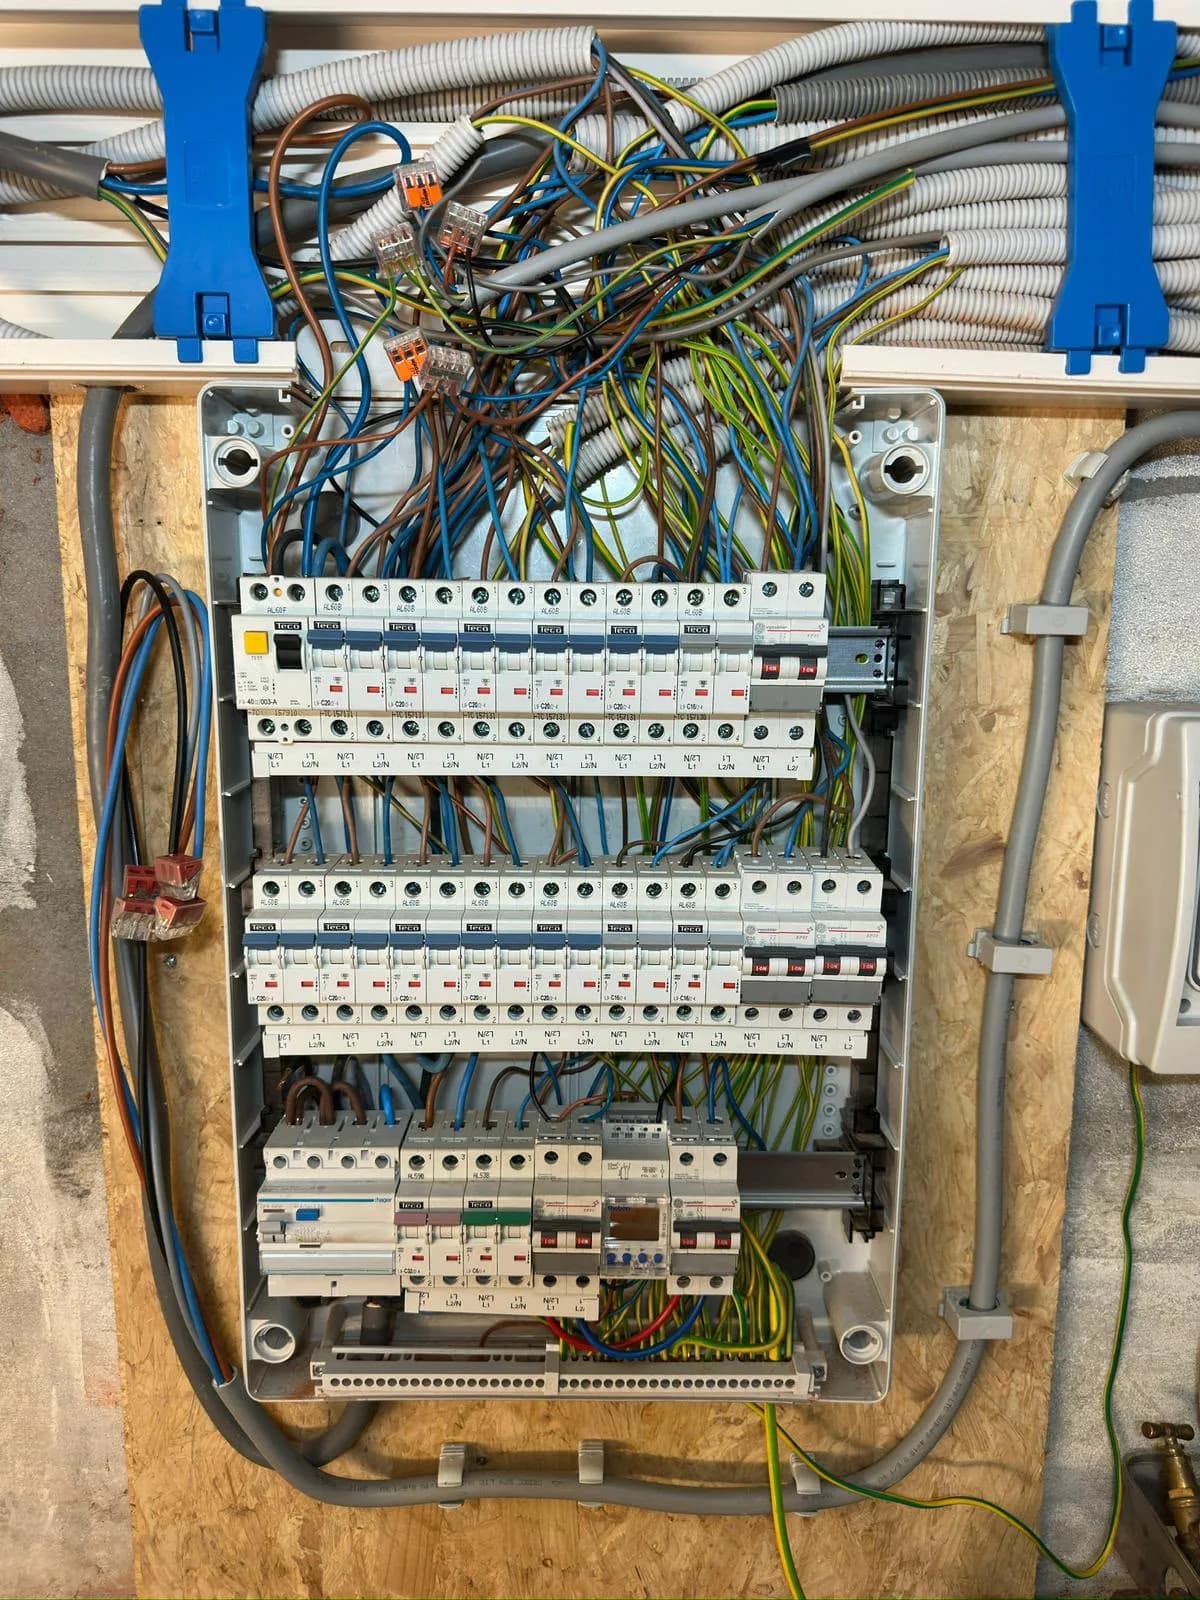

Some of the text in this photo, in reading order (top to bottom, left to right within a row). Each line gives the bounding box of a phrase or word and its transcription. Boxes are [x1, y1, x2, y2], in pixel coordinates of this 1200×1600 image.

[275, 622, 300, 630] Teco
[315, 621, 339, 629] Teco
[390, 623, 415, 631] Teco
[466, 624, 489, 632] Teco
[539, 625, 562, 633] Teco
[685, 625, 709, 633] Teco
[612, 626, 636, 634] Teco
[251, 923, 275, 931] Teco
[325, 923, 349, 931] Teco
[538, 924, 561, 932] Teco
[609, 924, 632, 932] Teco
[679, 925, 702, 933] Teco
